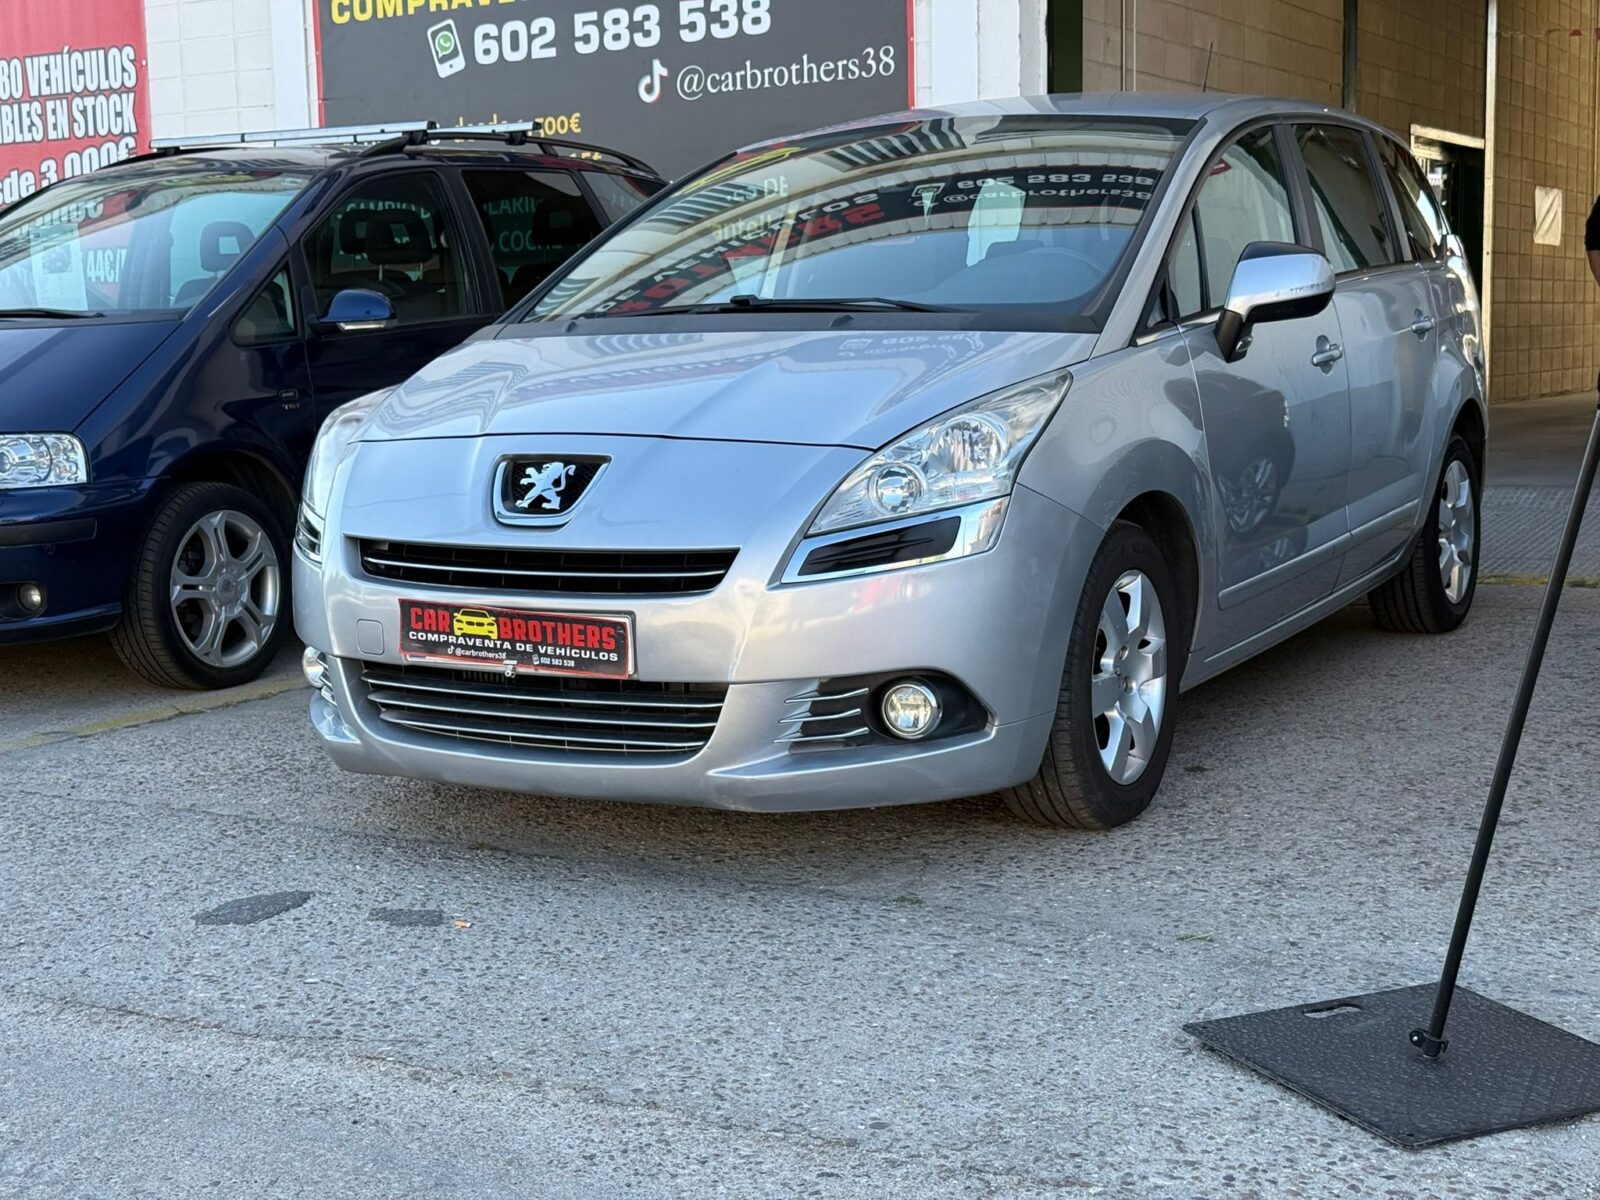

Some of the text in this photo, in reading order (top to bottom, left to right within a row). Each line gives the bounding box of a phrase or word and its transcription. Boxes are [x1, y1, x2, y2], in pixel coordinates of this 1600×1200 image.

[474, 0, 771, 65] 602 583 538
[25, 45, 137, 97] VEHÍCULOS
[676, 45, 895, 100] @carbrothers38
[46, 98, 70, 140] EN
[72, 92, 138, 138] STOCK
[0, 169, 36, 205] de
[409, 631, 618, 661] COMPRAVENTA DE VEHÍCULOS
[410, 607, 616, 650] CAR BROTHERS
